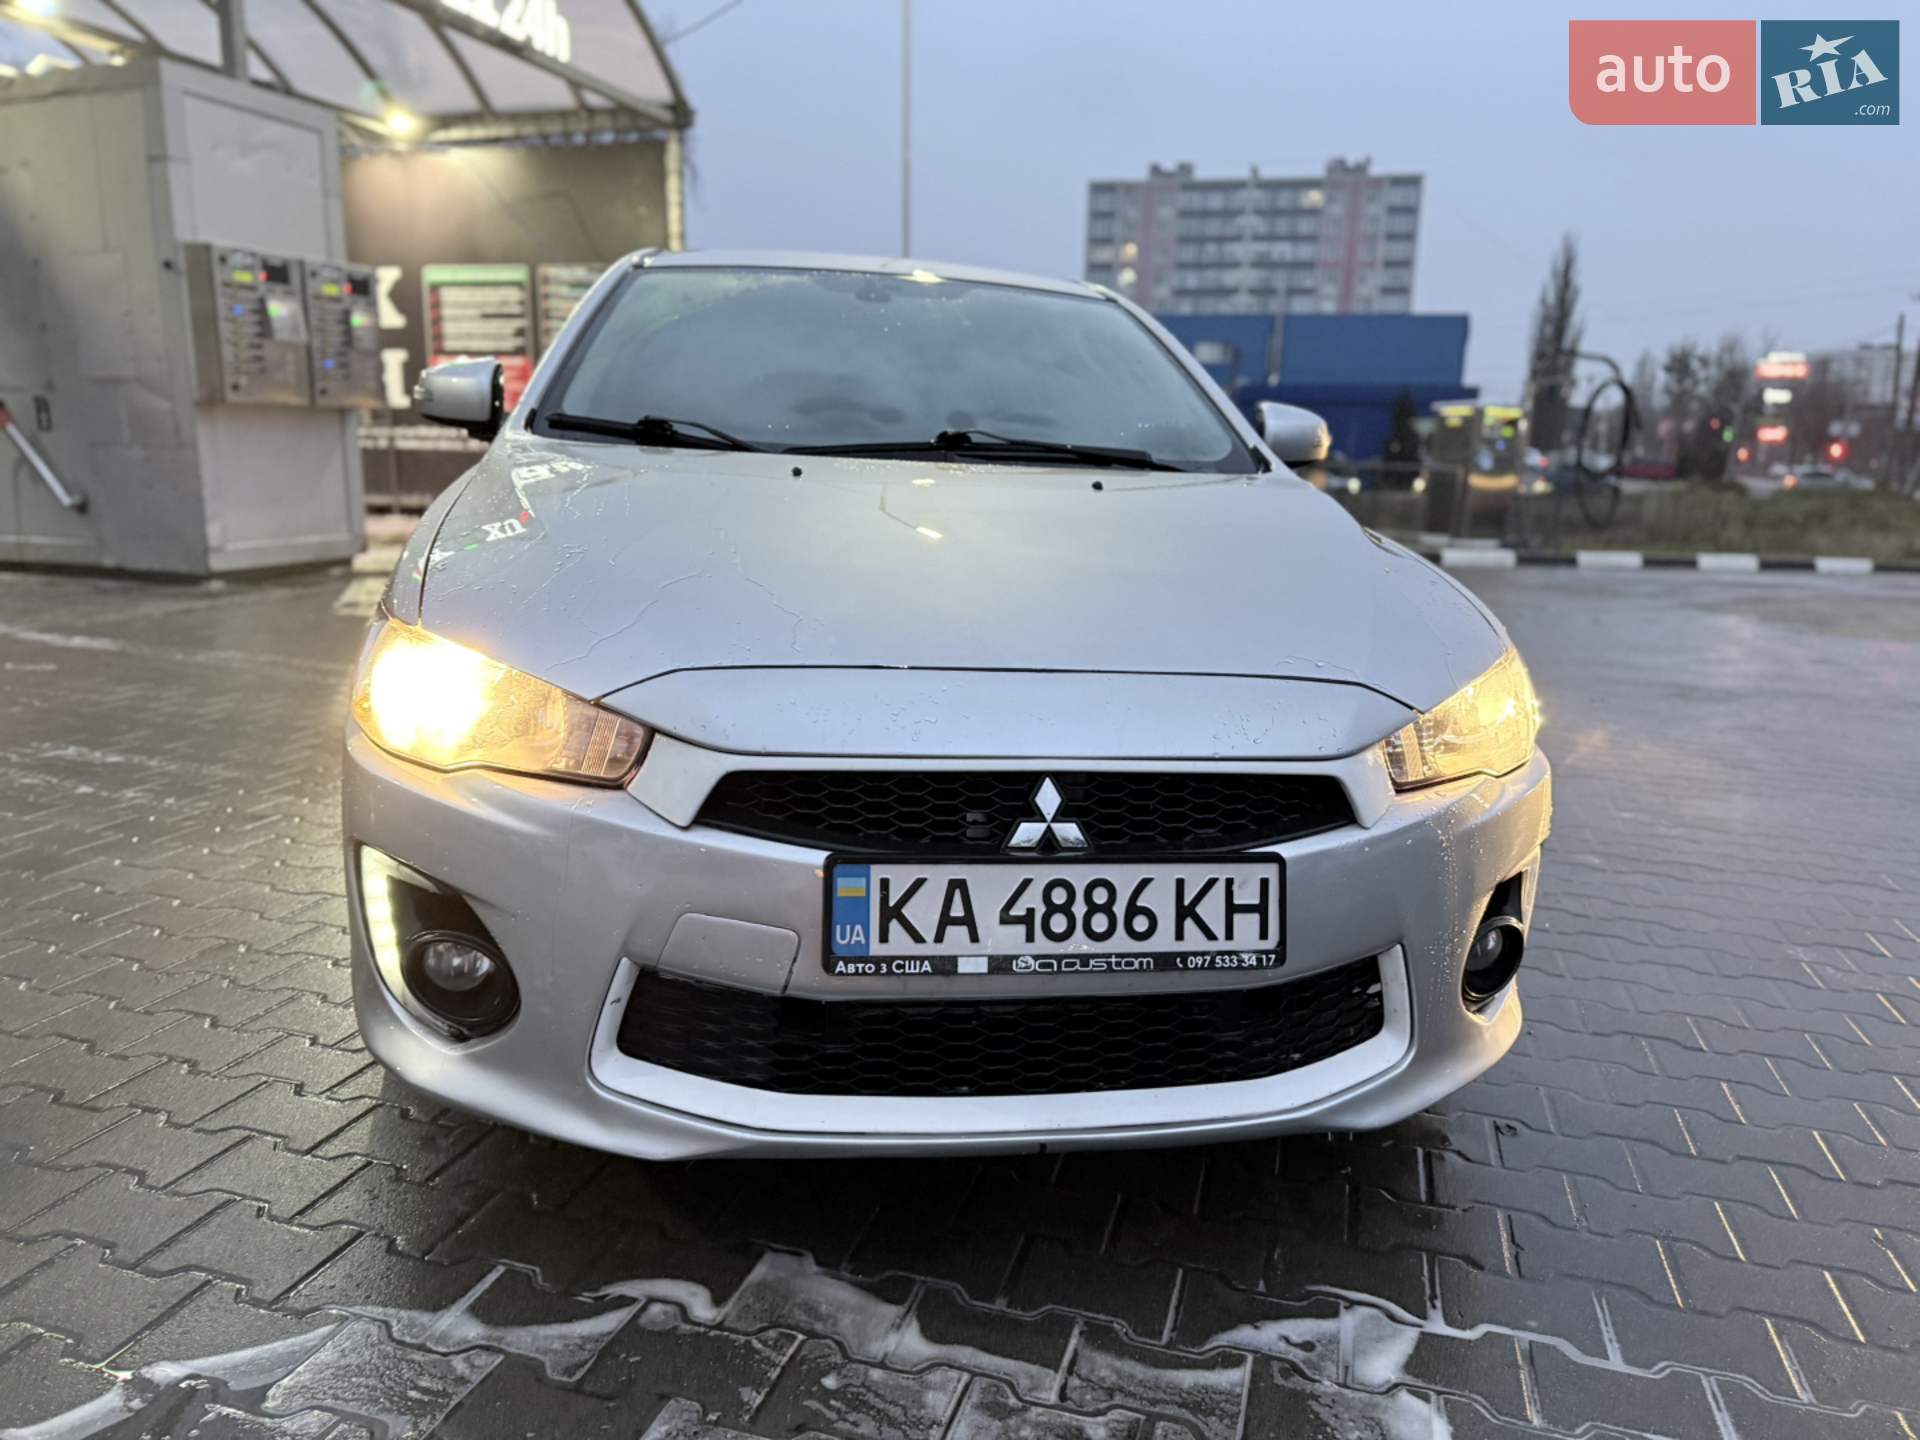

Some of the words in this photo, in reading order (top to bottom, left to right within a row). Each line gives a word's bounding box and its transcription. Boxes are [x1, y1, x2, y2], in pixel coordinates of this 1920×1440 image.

[878, 877, 980, 944] KA
[999, 877, 1158, 943] 4886
[1174, 877, 1270, 942] KH
[835, 924, 866, 945] UA
[891, 960, 933, 973] США
[1061, 954, 1154, 971] custom
[1187, 956, 1211, 968] 097
[1214, 955, 1238, 968] 533
[1241, 954, 1257, 967] 34
[1261, 954, 1276, 967] 17
